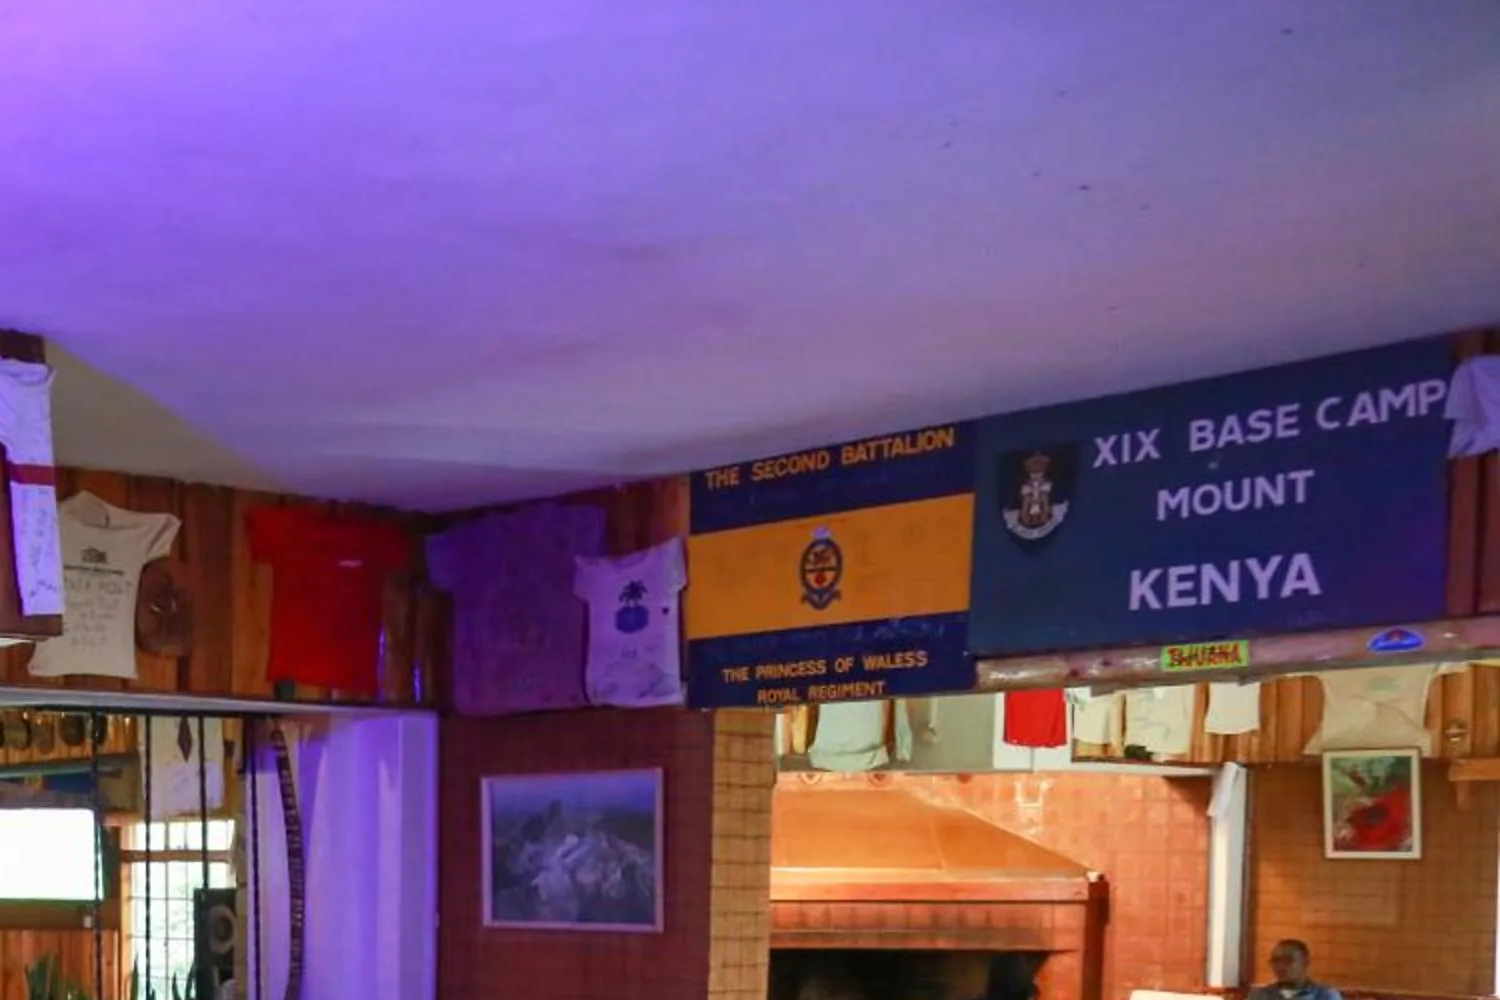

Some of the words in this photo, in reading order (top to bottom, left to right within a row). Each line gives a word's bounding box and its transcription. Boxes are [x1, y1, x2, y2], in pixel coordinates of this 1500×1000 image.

[1092, 427, 1161, 469] XIX
[1188, 402, 1301, 453] BASE
[1316, 378, 1448, 431] CAMP
[705, 466, 741, 490] THE
[751, 450, 831, 482] SECOND
[841, 427, 955, 466] BATTALION
[1155, 469, 1316, 522] MOUNT
[1127, 552, 1323, 611] KENYA
[722, 667, 748, 684] THE
[755, 659, 827, 680] PRINCESS
[835, 657, 854, 673] OF
[757, 689, 799, 705] ROYAL
[808, 680, 887, 700] REGIMENT
